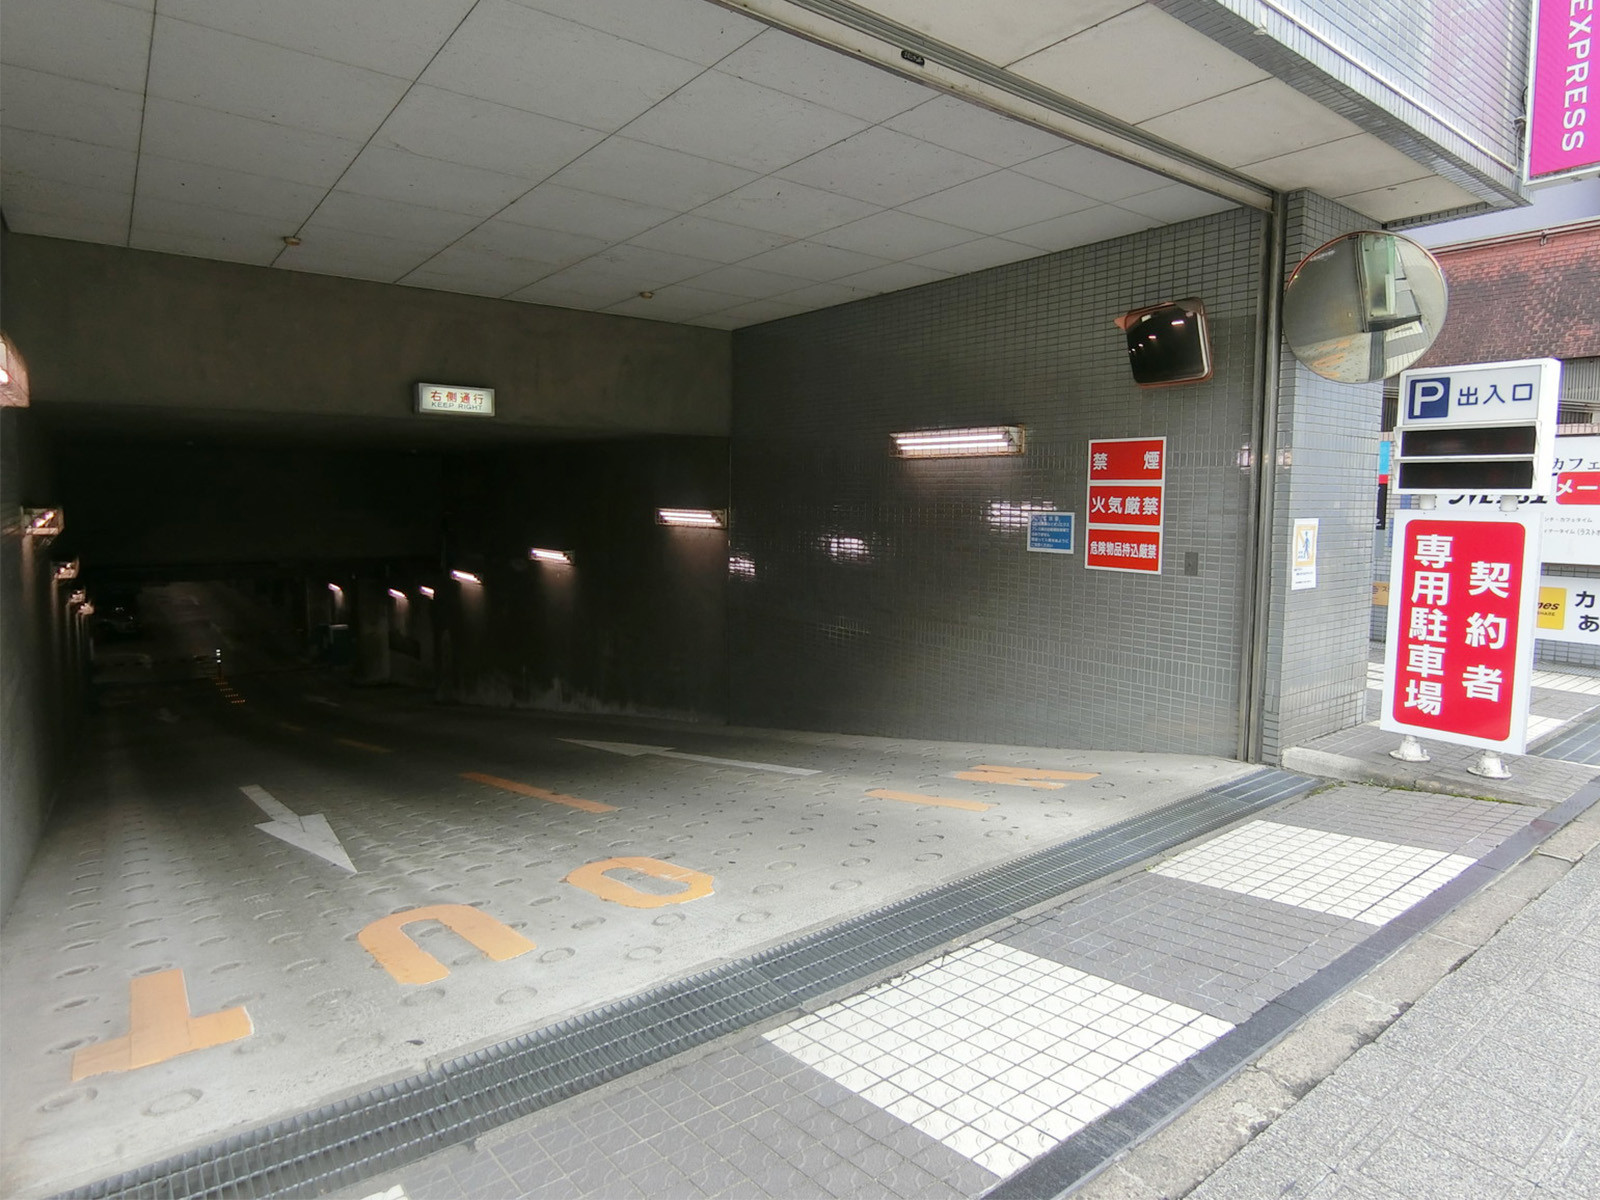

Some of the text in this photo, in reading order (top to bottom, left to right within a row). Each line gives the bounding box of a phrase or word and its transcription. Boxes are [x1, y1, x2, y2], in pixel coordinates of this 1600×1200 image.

[1561, 0, 1594, 152] EXPRESS
[430, 390, 484, 405] 右側通行
[431, 401, 483, 411] KEEP RIGHT
[1413, 381, 1533, 416] P 出入口
[1091, 496, 1159, 515] 火気厳禁
[1090, 541, 1157, 559] 危険物品持込厳禁
[1404, 534, 1454, 717] 専用駐車場
[1462, 561, 1511, 703] 契約者
[71, 856, 715, 1082] OUT
